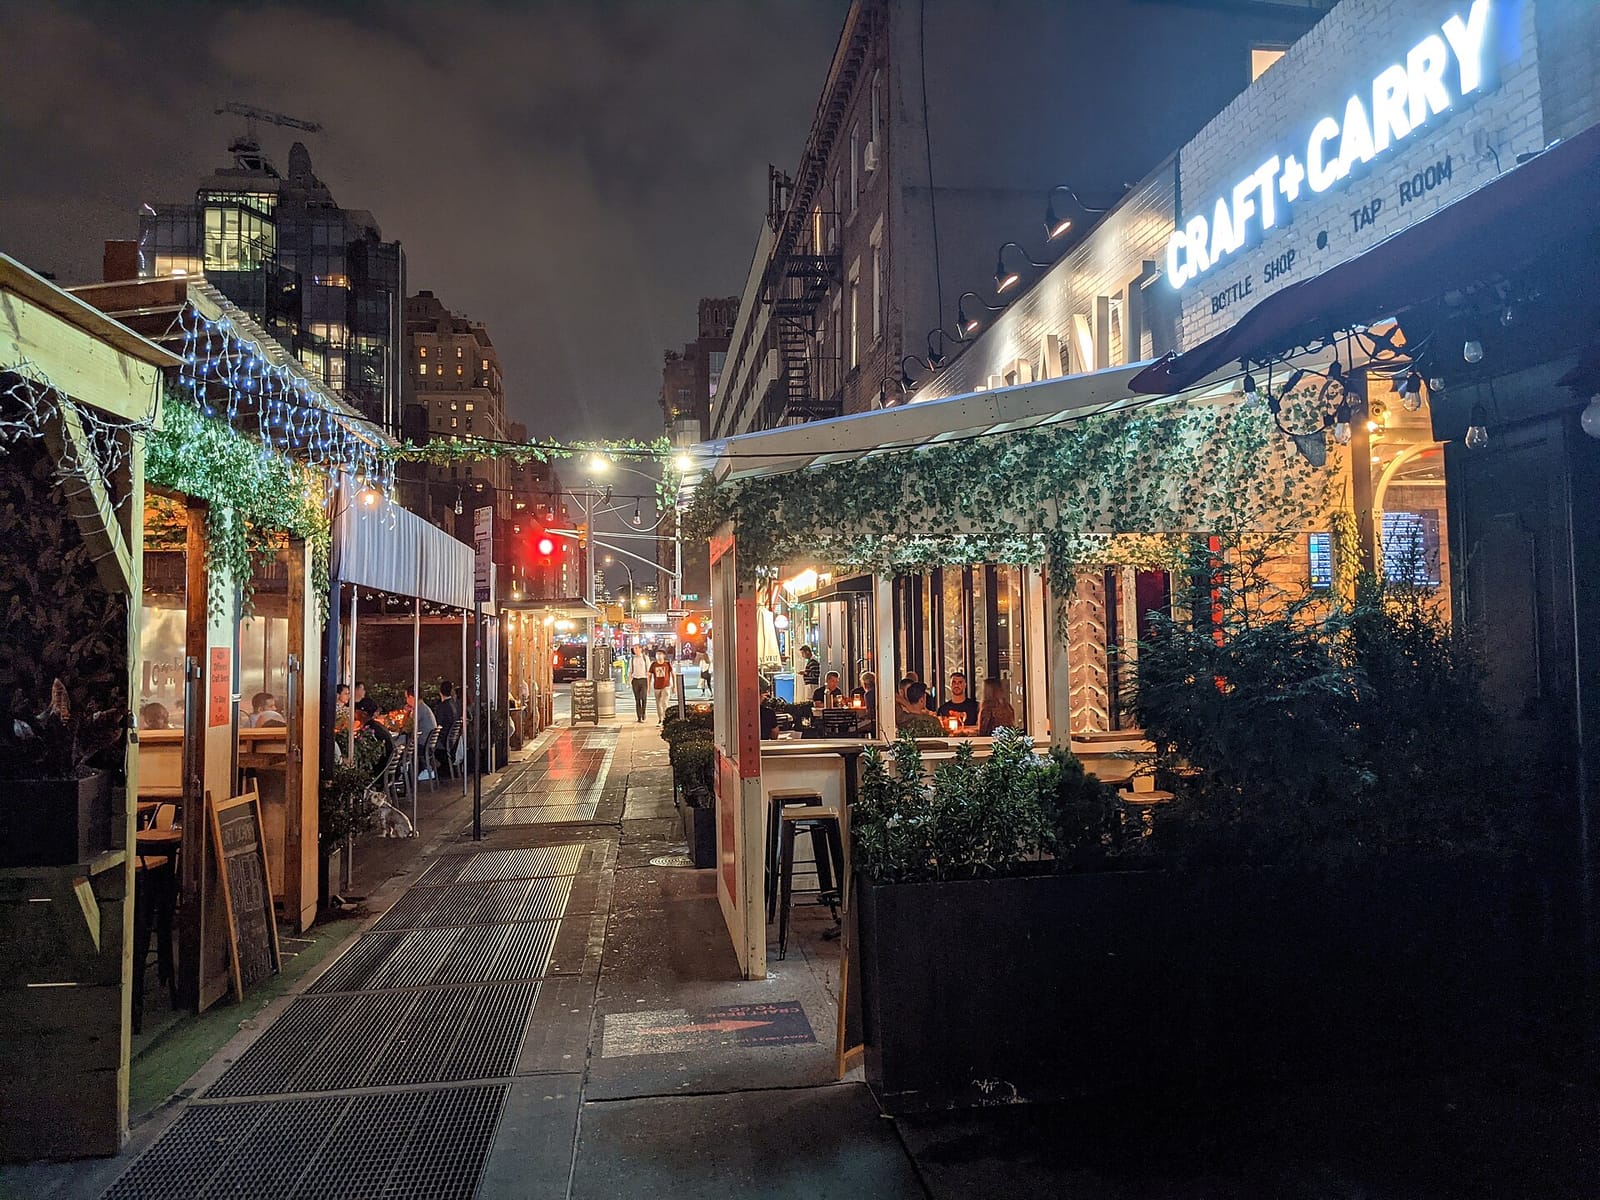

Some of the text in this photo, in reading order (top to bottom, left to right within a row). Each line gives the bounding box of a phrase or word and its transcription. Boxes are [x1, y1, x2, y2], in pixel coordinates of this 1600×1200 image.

[1211, 155, 1453, 316] BOTTLE SHOP TAP ROOM
